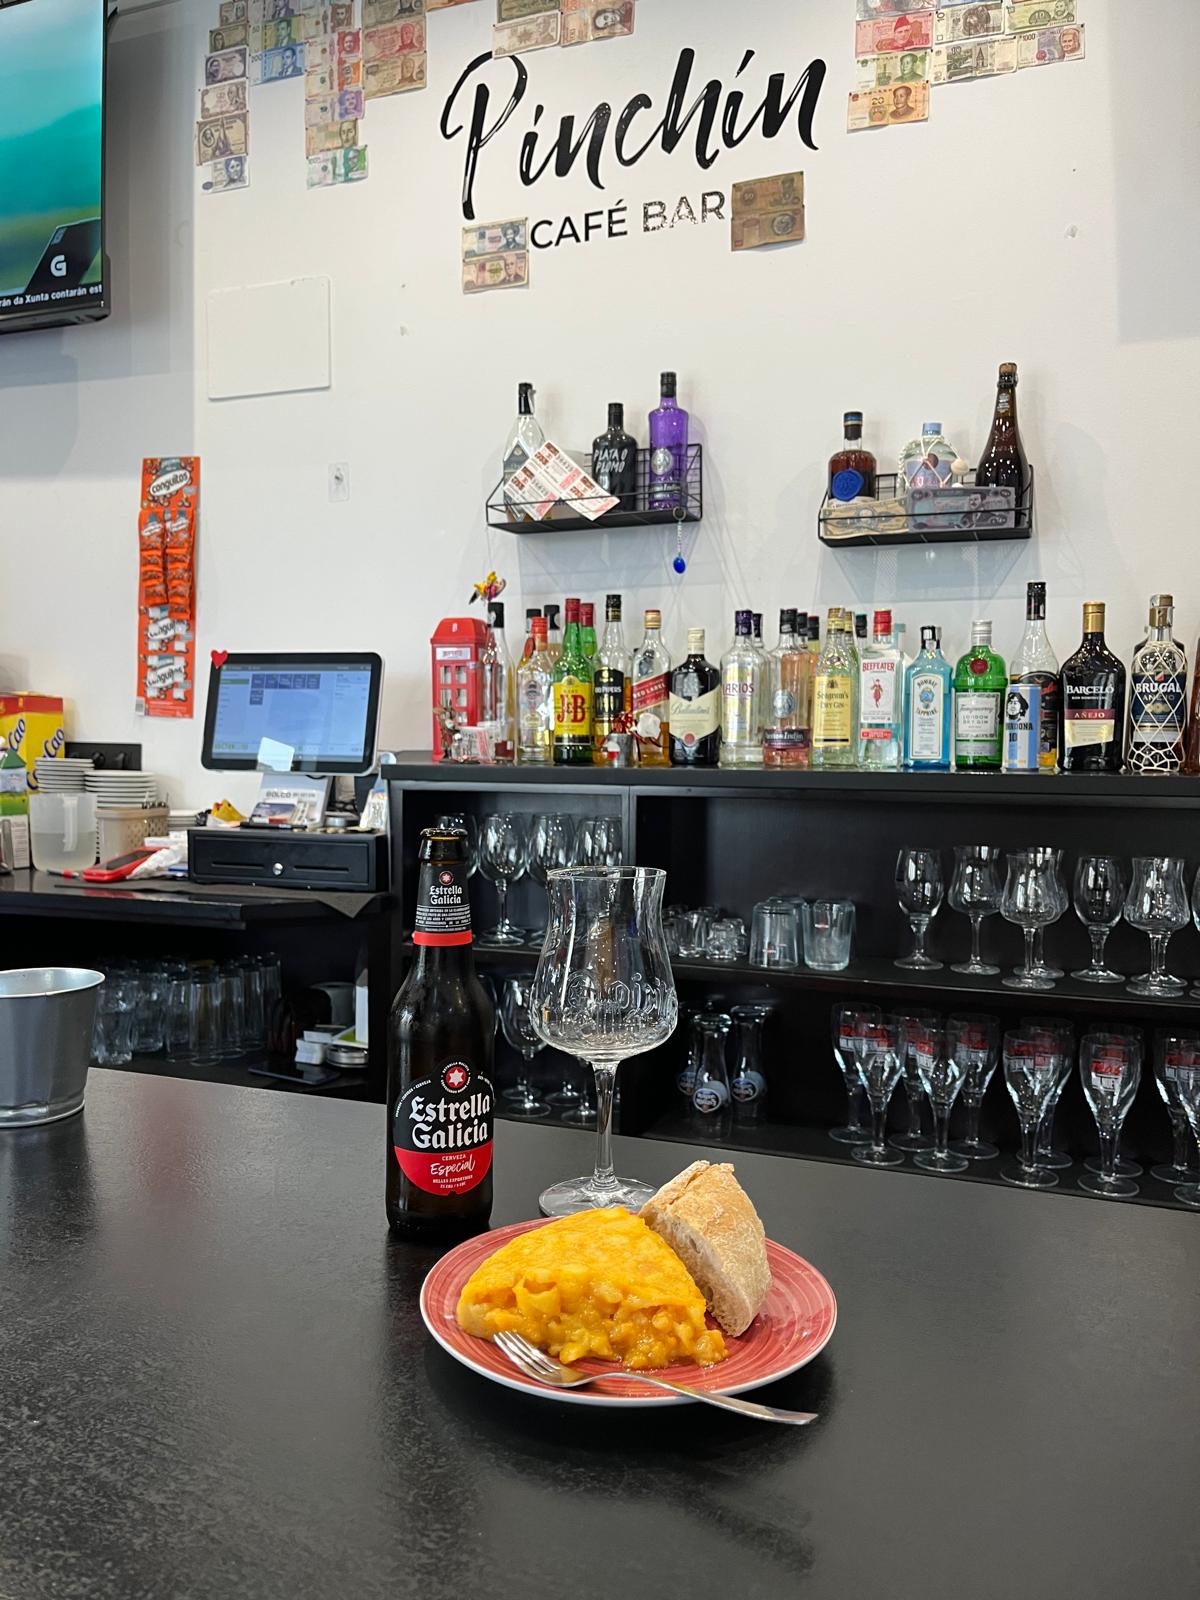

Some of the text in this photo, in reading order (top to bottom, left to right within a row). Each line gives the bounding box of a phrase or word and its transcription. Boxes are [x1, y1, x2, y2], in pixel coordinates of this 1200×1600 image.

[871, 96, 885, 105] 20
[440, 47, 827, 220] Pinchín
[530, 190, 726, 249] CAFÉ BAR
[13, 296, 23, 305] da
[25, 293, 49, 303] Xunta
[51, 286, 87, 300] contarán
[593, 449, 619, 461] PLATA
[595, 461, 625, 473] PLOMO
[862, 662, 895, 672] BEEFEATER
[646, 683, 665, 694] LABEL
[1066, 683, 1115, 695] BARCELÓ
[1136, 682, 1181, 693] BRUGAL
[557, 694, 586, 724] J&B
[1074, 711, 1105, 719] AÑEJO
[8, 718, 26, 752] Cao
[1009, 733, 1018, 742] 10
[44, 728, 65, 759] Cao
[429, 885, 463, 895] Estrella
[430, 894, 462, 905] Galicia
[409, 1092, 490, 1123] Estrella
[412, 1119, 488, 1149] Galicia
[430, 1154, 476, 1177] Especial
